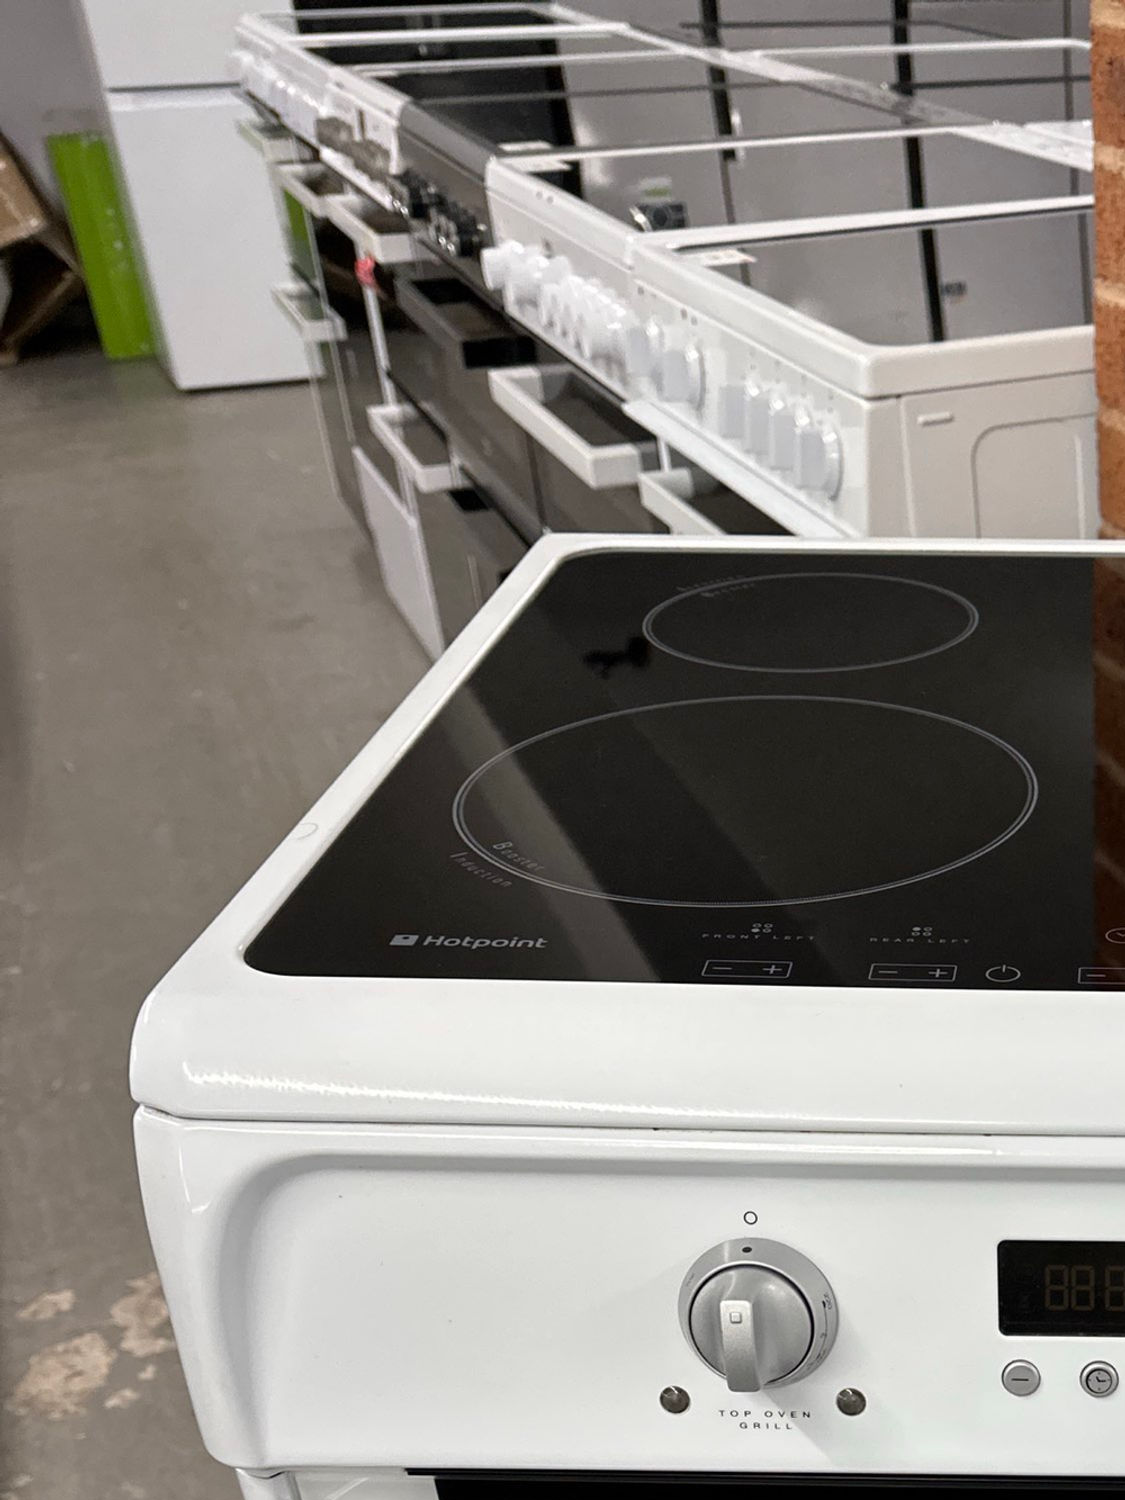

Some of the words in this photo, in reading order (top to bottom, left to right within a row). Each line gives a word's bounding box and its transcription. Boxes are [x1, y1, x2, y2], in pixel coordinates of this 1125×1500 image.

[701, 933, 762, 941] FRONT
[423, 935, 548, 950] Hotpoint
[719, 1409, 752, 1418] TOP
[763, 1410, 812, 1419] OVEN
[739, 1422, 793, 1430] GRILL
